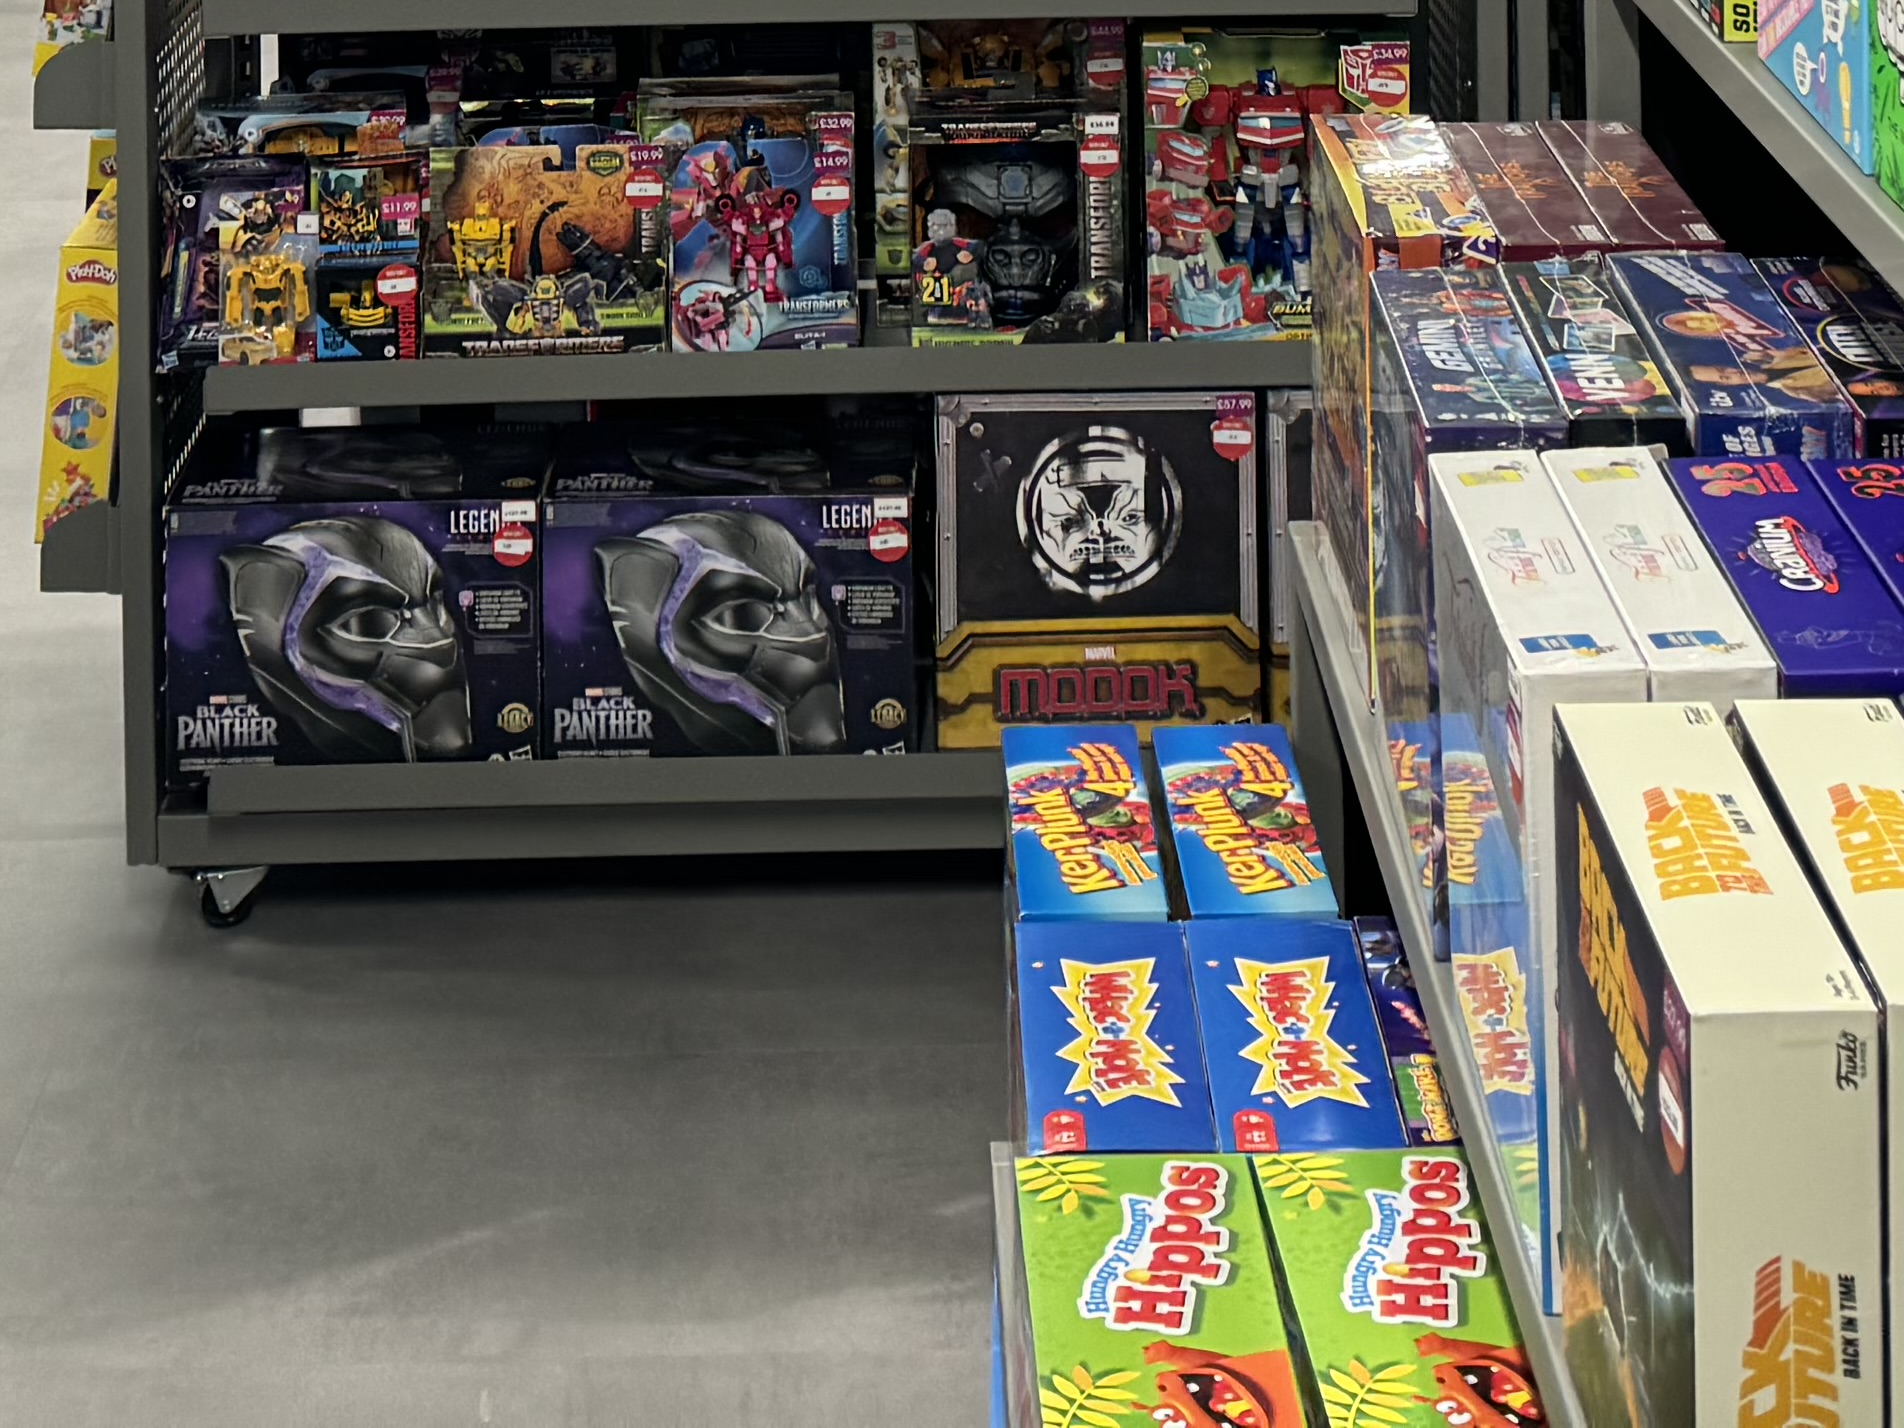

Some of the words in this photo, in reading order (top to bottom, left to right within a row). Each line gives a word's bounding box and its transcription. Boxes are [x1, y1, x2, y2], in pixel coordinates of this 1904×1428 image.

[1733, 4, 1750, 33] SO
[1569, 353, 1629, 403] VENN
[1755, 518, 1826, 595] CRANIUM
[196, 704, 261, 720] BLACK
[1000, 665, 1200, 719] MODOK
[177, 715, 278, 747] PANTHER
[1646, 803, 1717, 902] BACK
[1086, 1246, 1132, 1316] Hungry
[1115, 1194, 1154, 1262] Hungry
[1113, 1163, 1223, 1331] Hippos
[1838, 1273, 1856, 1312] TIME
[1841, 1315, 1859, 1333] IN
[1843, 1337, 1861, 1380] BACK
